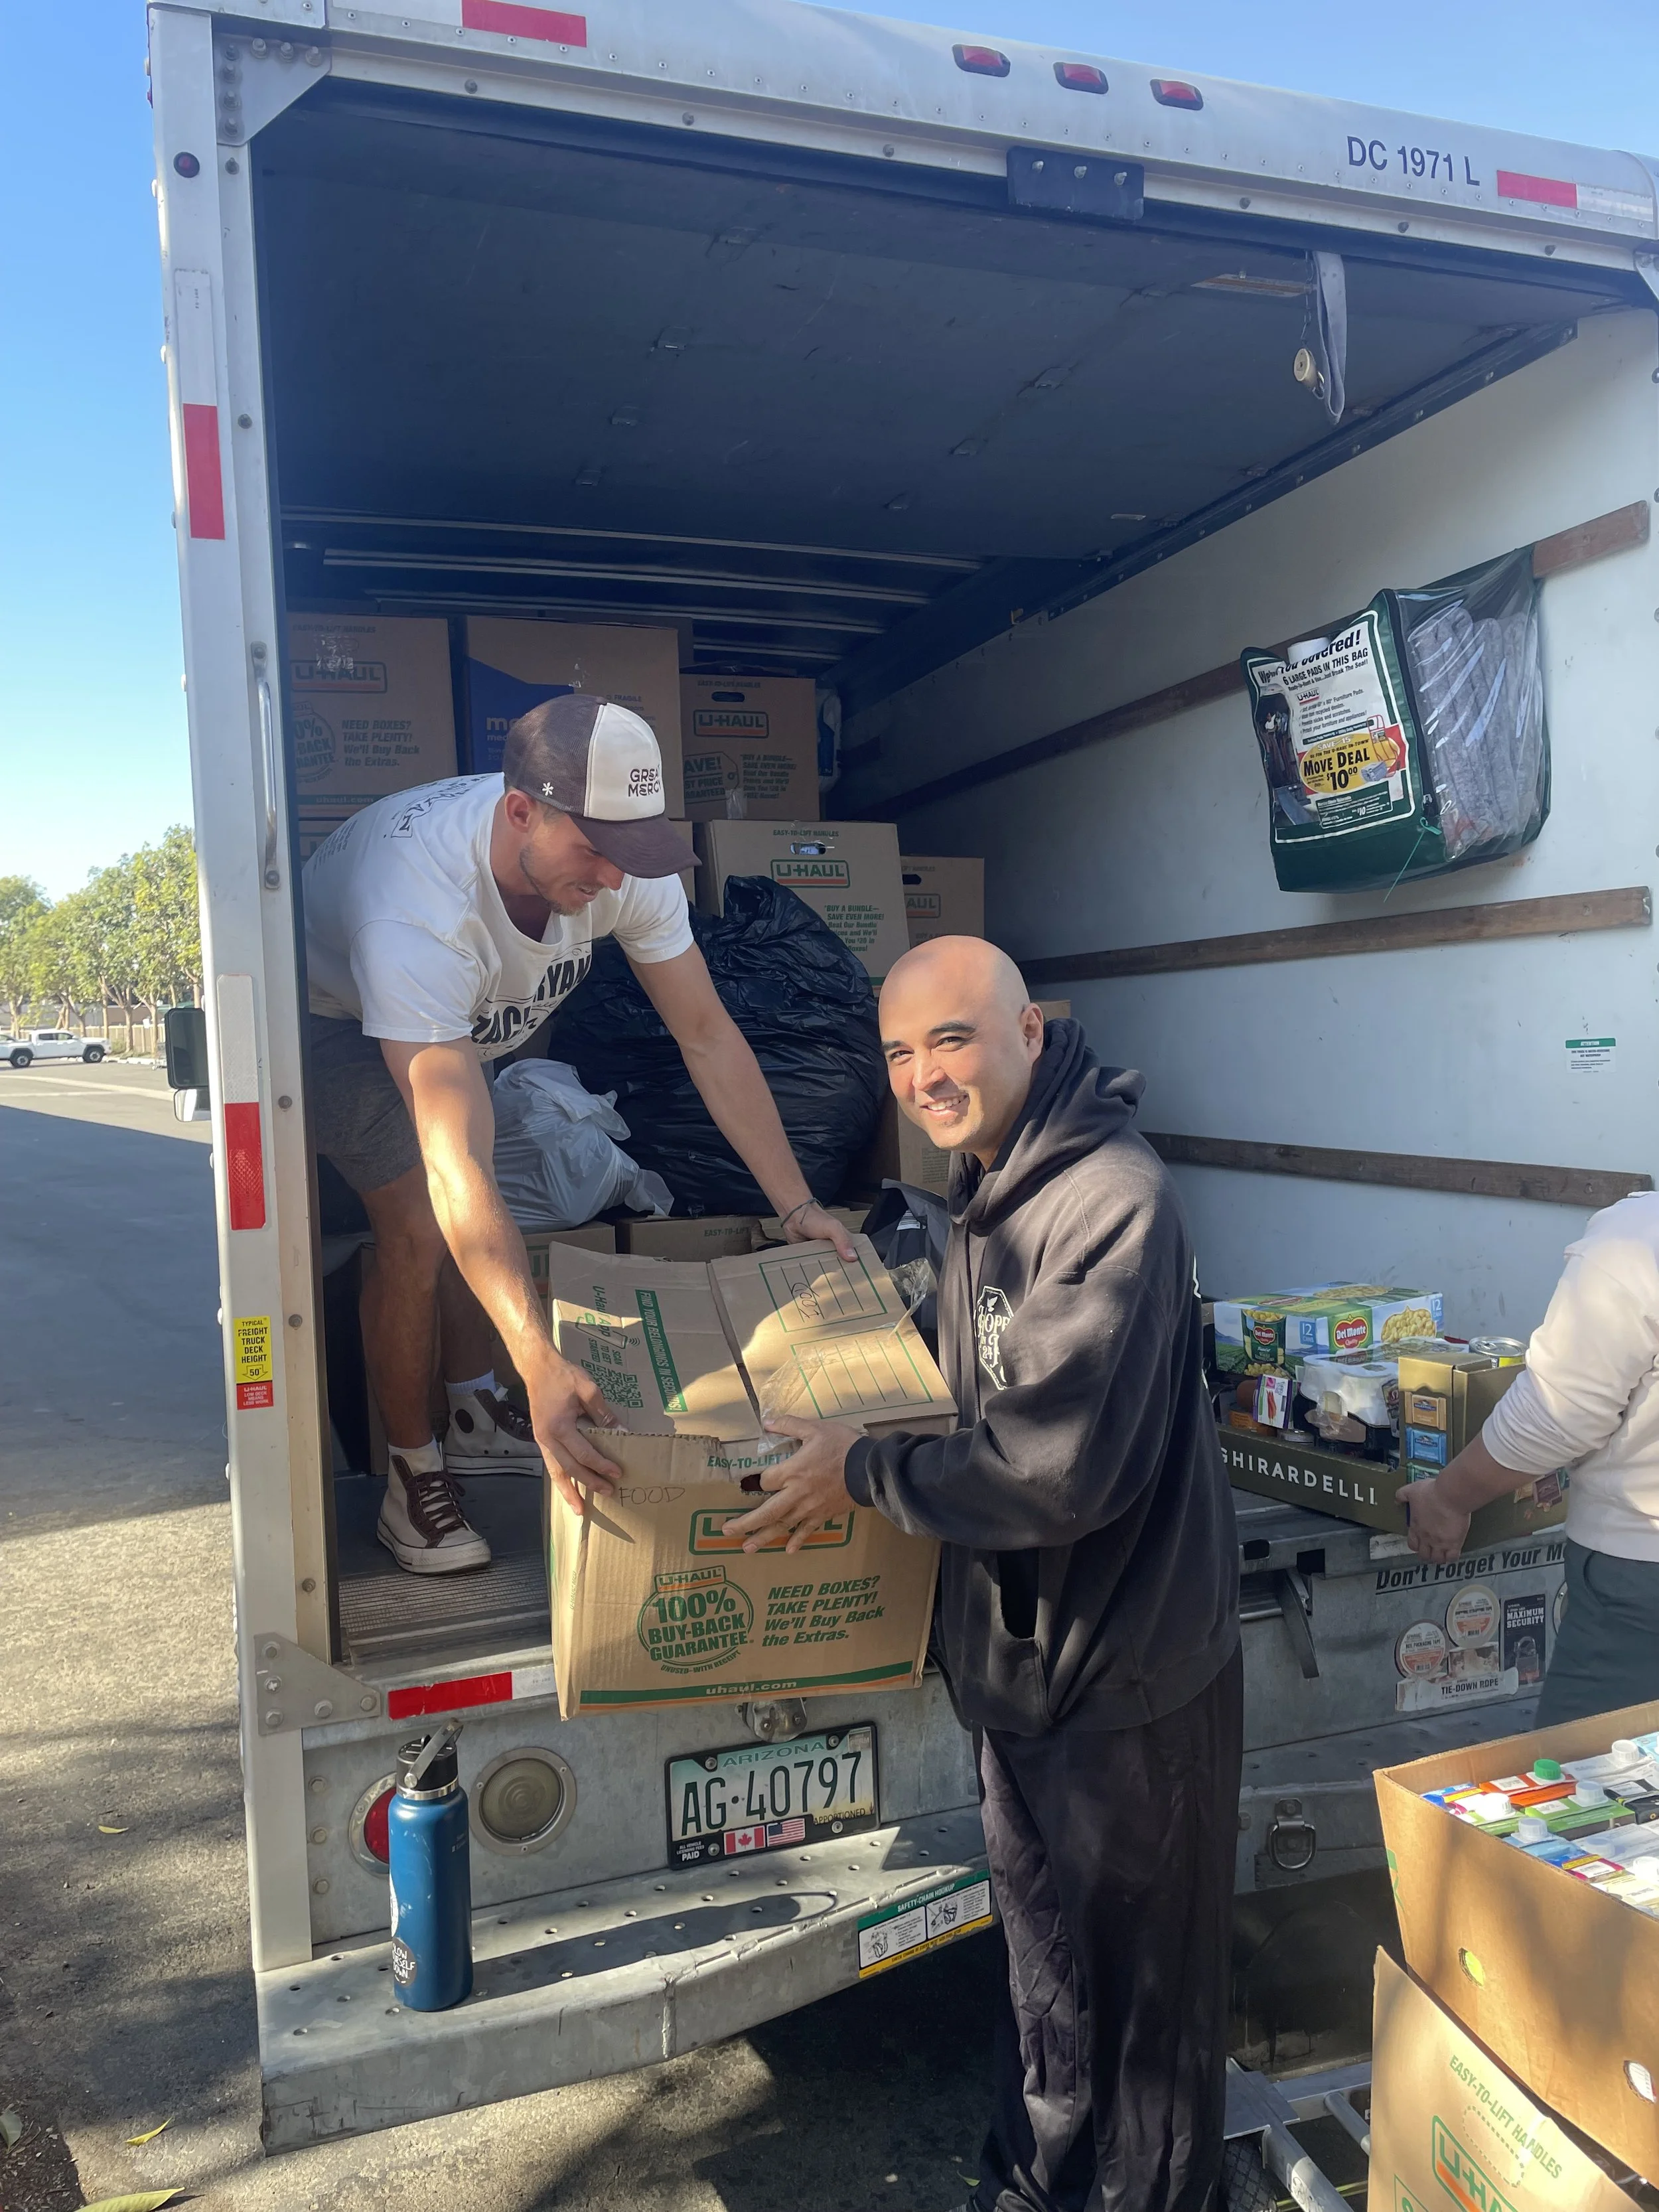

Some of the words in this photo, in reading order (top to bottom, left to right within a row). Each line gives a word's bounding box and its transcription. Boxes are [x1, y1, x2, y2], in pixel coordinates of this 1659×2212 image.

[1347, 136, 1387, 171] DC
[1398, 146, 1453, 182] 1971
[1465, 157, 1480, 186] L
[1289, 672, 1307, 684] LARGE
[1307, 666, 1323, 680] PADS
[1333, 655, 1349, 668] THIS
[1352, 648, 1368, 662] BAG
[1297, 689, 1319, 701] U-HAUL
[342, 720, 369, 729] NEED
[372, 721, 411, 730] BOXES?
[699, 714, 764, 728] U-HAUL
[343, 733, 368, 742] TAKE
[1317, 741, 1336, 751] SAVE
[372, 745, 392, 756] Buy
[395, 745, 419, 755] Back
[344, 757, 361, 766] the
[1303, 758, 1333, 777] MOVE
[1337, 748, 1370, 769] DEAL
[776, 864, 845, 877] U-HAUL
[593, 1286, 611, 1318] U-Haul
[640, 1291, 654, 1307] FIND
[1432, 1299, 1442, 1311] 12
[644, 1309, 658, 1328] YOUR
[238, 1327, 268, 1337] FREIGHT
[598, 1318, 612, 1337] App
[1302, 1322, 1313, 1336] 12
[1336, 1329, 1346, 1340] Del
[1347, 1325, 1366, 1338] Monte
[242, 1337, 265, 1345] TRUCK
[601, 1344, 609, 1353] TO
[648, 1327, 670, 1367] BELONGINGS
[242, 1354, 267, 1363] HEIGHT
[244, 1345, 263, 1355] DECK
[588, 1338, 601, 1363] STARTED
[601, 1353, 612, 1364] GET
[612, 1349, 623, 1366] SCAN
[658, 1366, 672, 1375] IN
[661, 1375, 684, 1412] SECONDS!
[707, 1453, 781, 1469] EASY-TO-LIFT
[1221, 1447, 1376, 1505] GHIRARDELLI
[618, 1486, 685, 1507] FOOD
[658, 1569, 721, 1587] U-HAUL
[1376, 1565, 1428, 1591] Don't
[1434, 1554, 1494, 1580] Forget
[1502, 1549, 1542, 1569] Your
[768, 1584, 814, 1600] NEED
[818, 1576, 881, 1595] BOXES?
[652, 1587, 735, 1623] 100%
[768, 1599, 808, 1615] TAKE
[812, 1591, 877, 1612] PLENTY!
[764, 1614, 805, 1632] We'll
[808, 1611, 841, 1631] Buy
[845, 1605, 886, 1621] Back
[1507, 1607, 1544, 1621] MAXIMUM
[1507, 1615, 1544, 1629] SECURITY
[648, 1613, 747, 1645] BUY-BACK
[762, 1632, 790, 1647] the
[794, 1628, 849, 1645] Extras.
[650, 1630, 749, 1662] GUARANTEE
[713, 1649, 741, 1669] RECEIPT
[706, 1680, 797, 1696] uhaul.com
[1441, 1681, 1478, 1694] TIE-DOWN
[1480, 1678, 1498, 1688] ROPE
[721, 1740, 826, 1768] ARIZONA
[814, 1806, 866, 1826] APPORTIONED
[682, 1851, 699, 1861] PAID
[897, 1891, 934, 1912] SAFETY-CHAIN
[935, 1883, 955, 1897] HOOKUP
[1449, 2053, 1514, 2130] EASY-TO-LIFT
[1511, 2122, 1563, 2179] HANDLES
